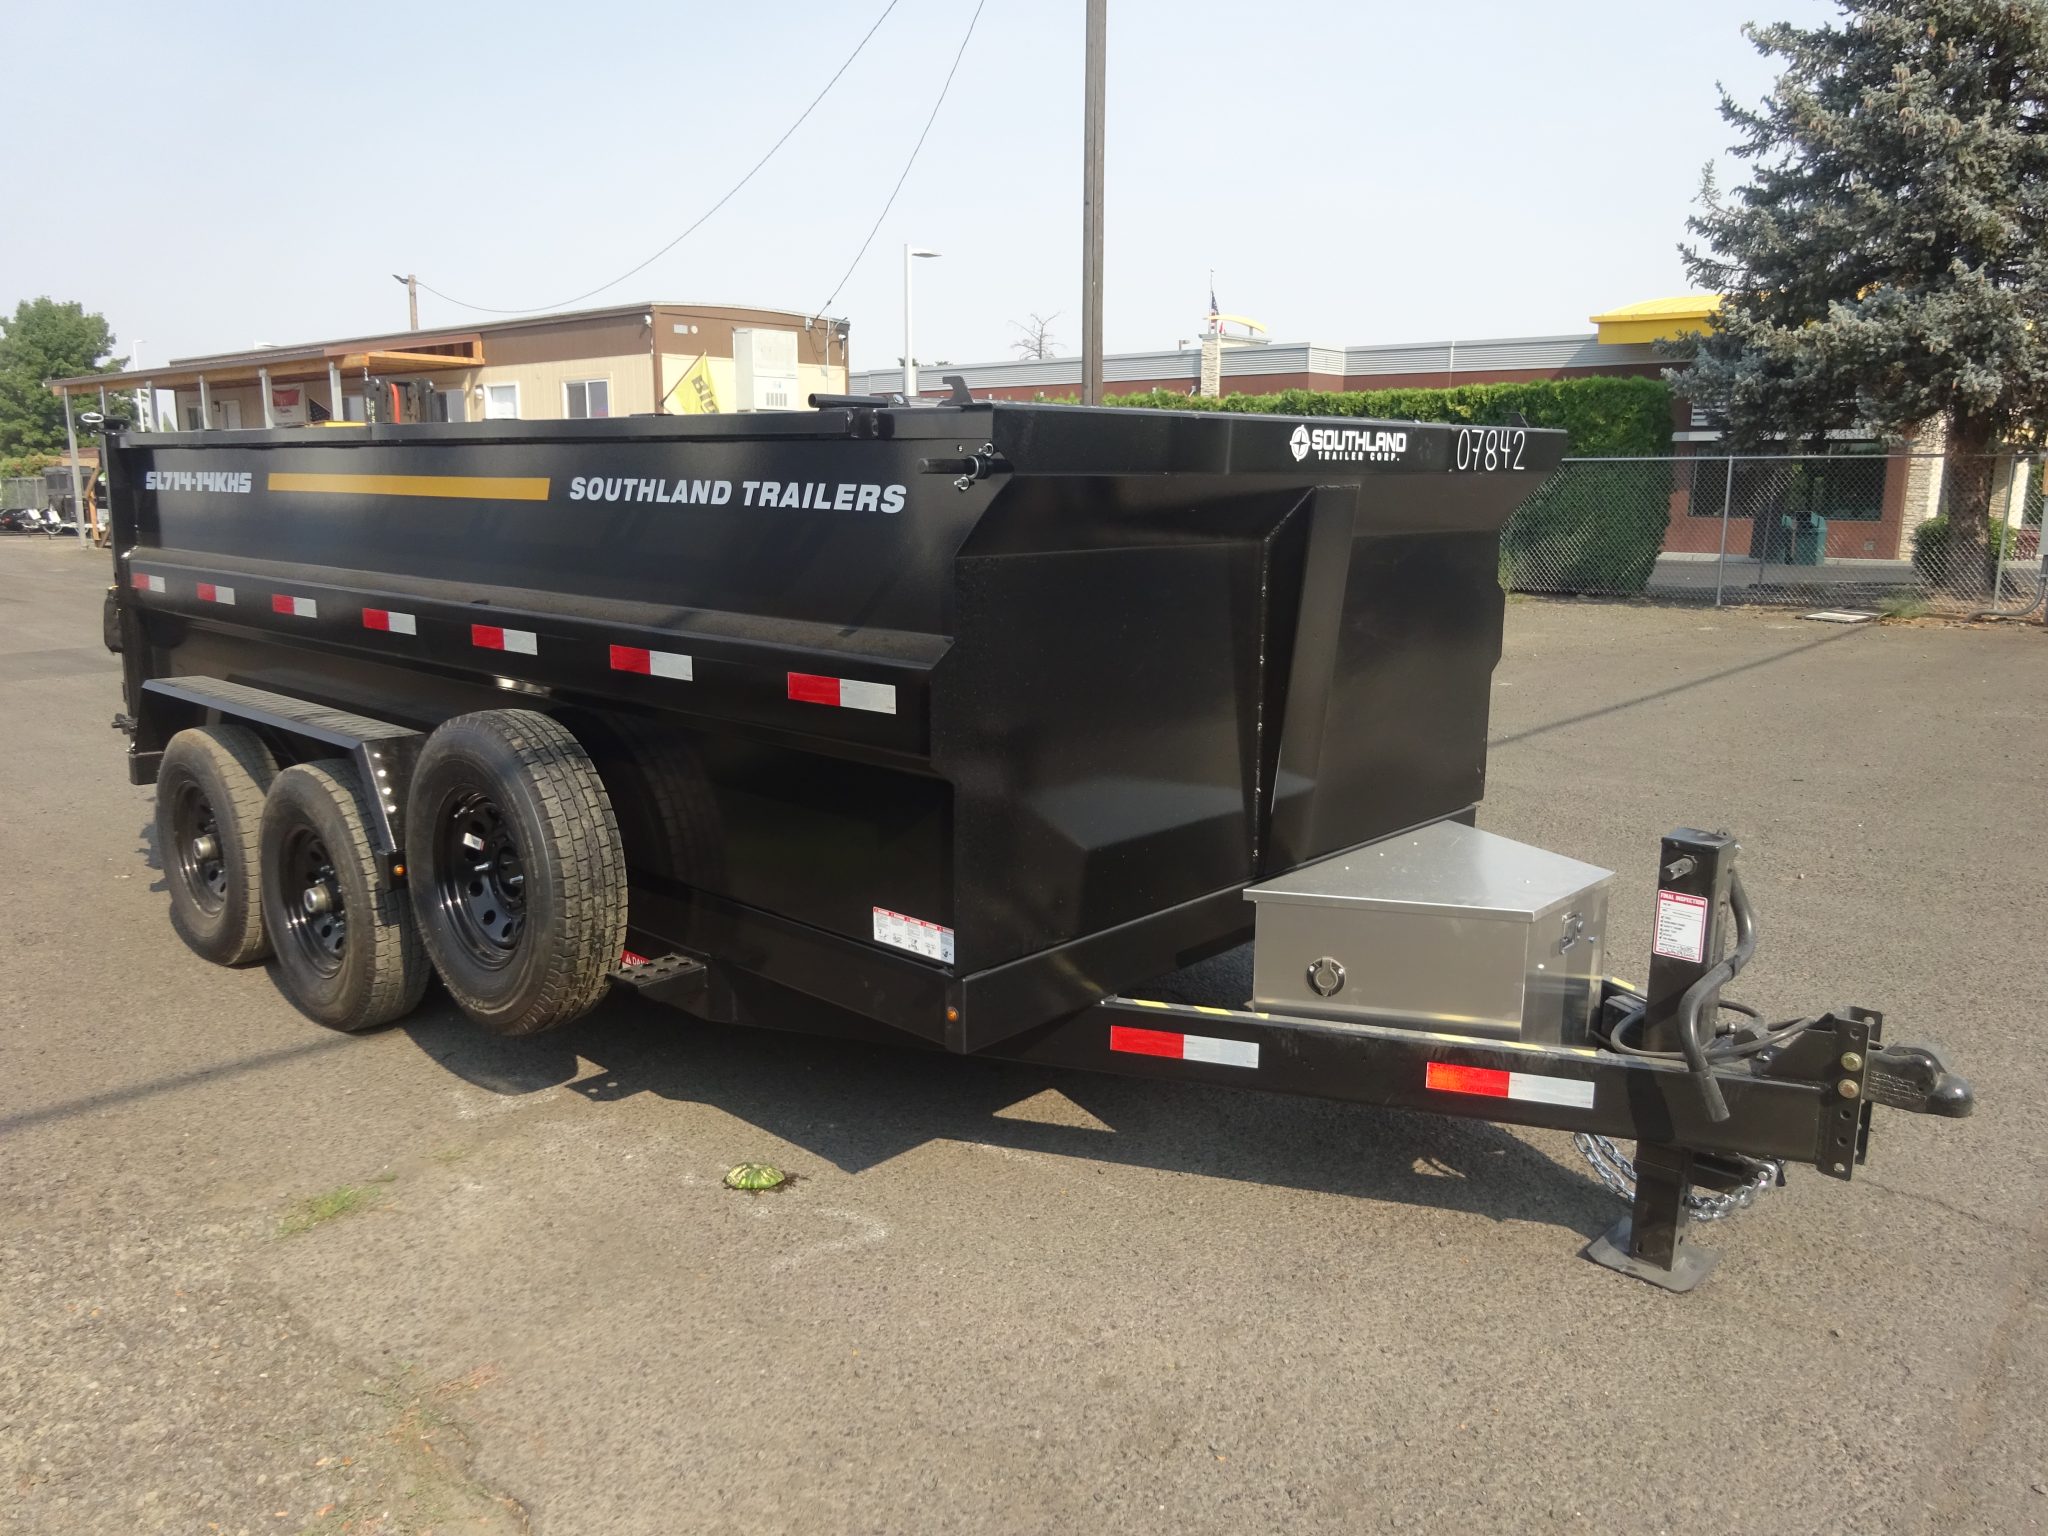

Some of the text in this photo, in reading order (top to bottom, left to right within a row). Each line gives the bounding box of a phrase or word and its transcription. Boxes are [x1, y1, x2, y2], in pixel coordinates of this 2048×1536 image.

[1311, 429, 1407, 452] SOUTHLAND
[1457, 428, 1526, 471] 07842
[1317, 451, 1400, 462] TRAILER CORP.
[145, 471, 252, 494] SL714-14KHS
[569, 476, 907, 514] SOUTHLAND TRAILERS
